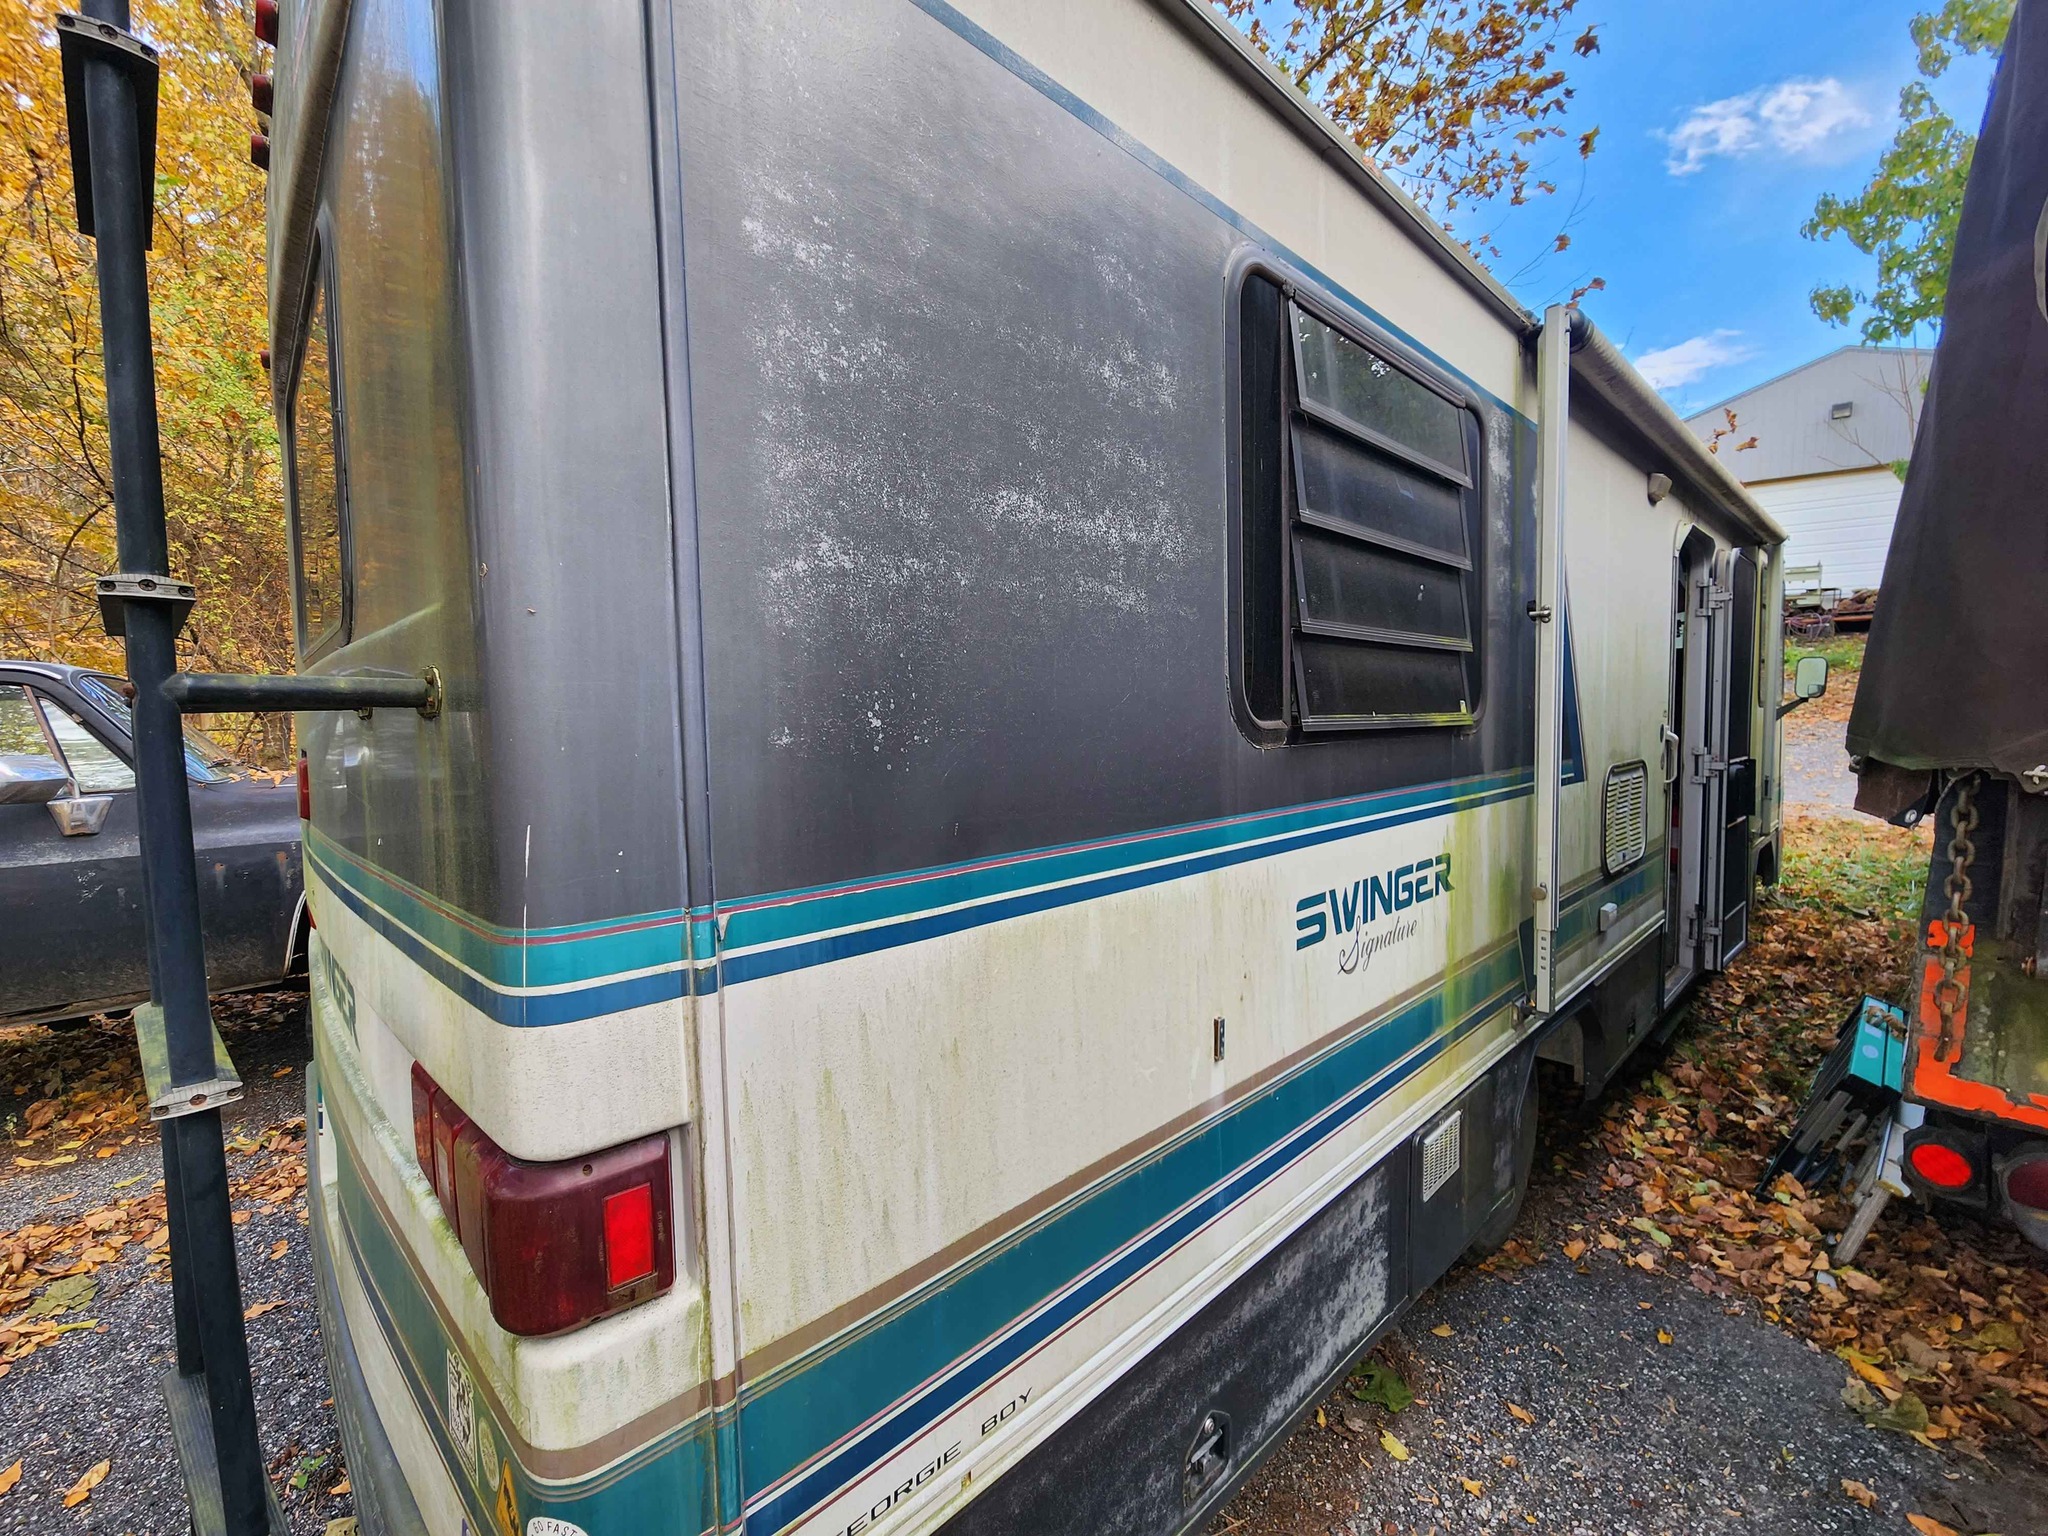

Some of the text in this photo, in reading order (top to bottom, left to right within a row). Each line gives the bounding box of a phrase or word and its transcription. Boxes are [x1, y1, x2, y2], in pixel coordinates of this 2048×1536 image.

[1296, 852, 1455, 951] SWINGER
[1337, 915, 1417, 975] Signature
[835, 1387, 1033, 1536] EORGIE BOY
